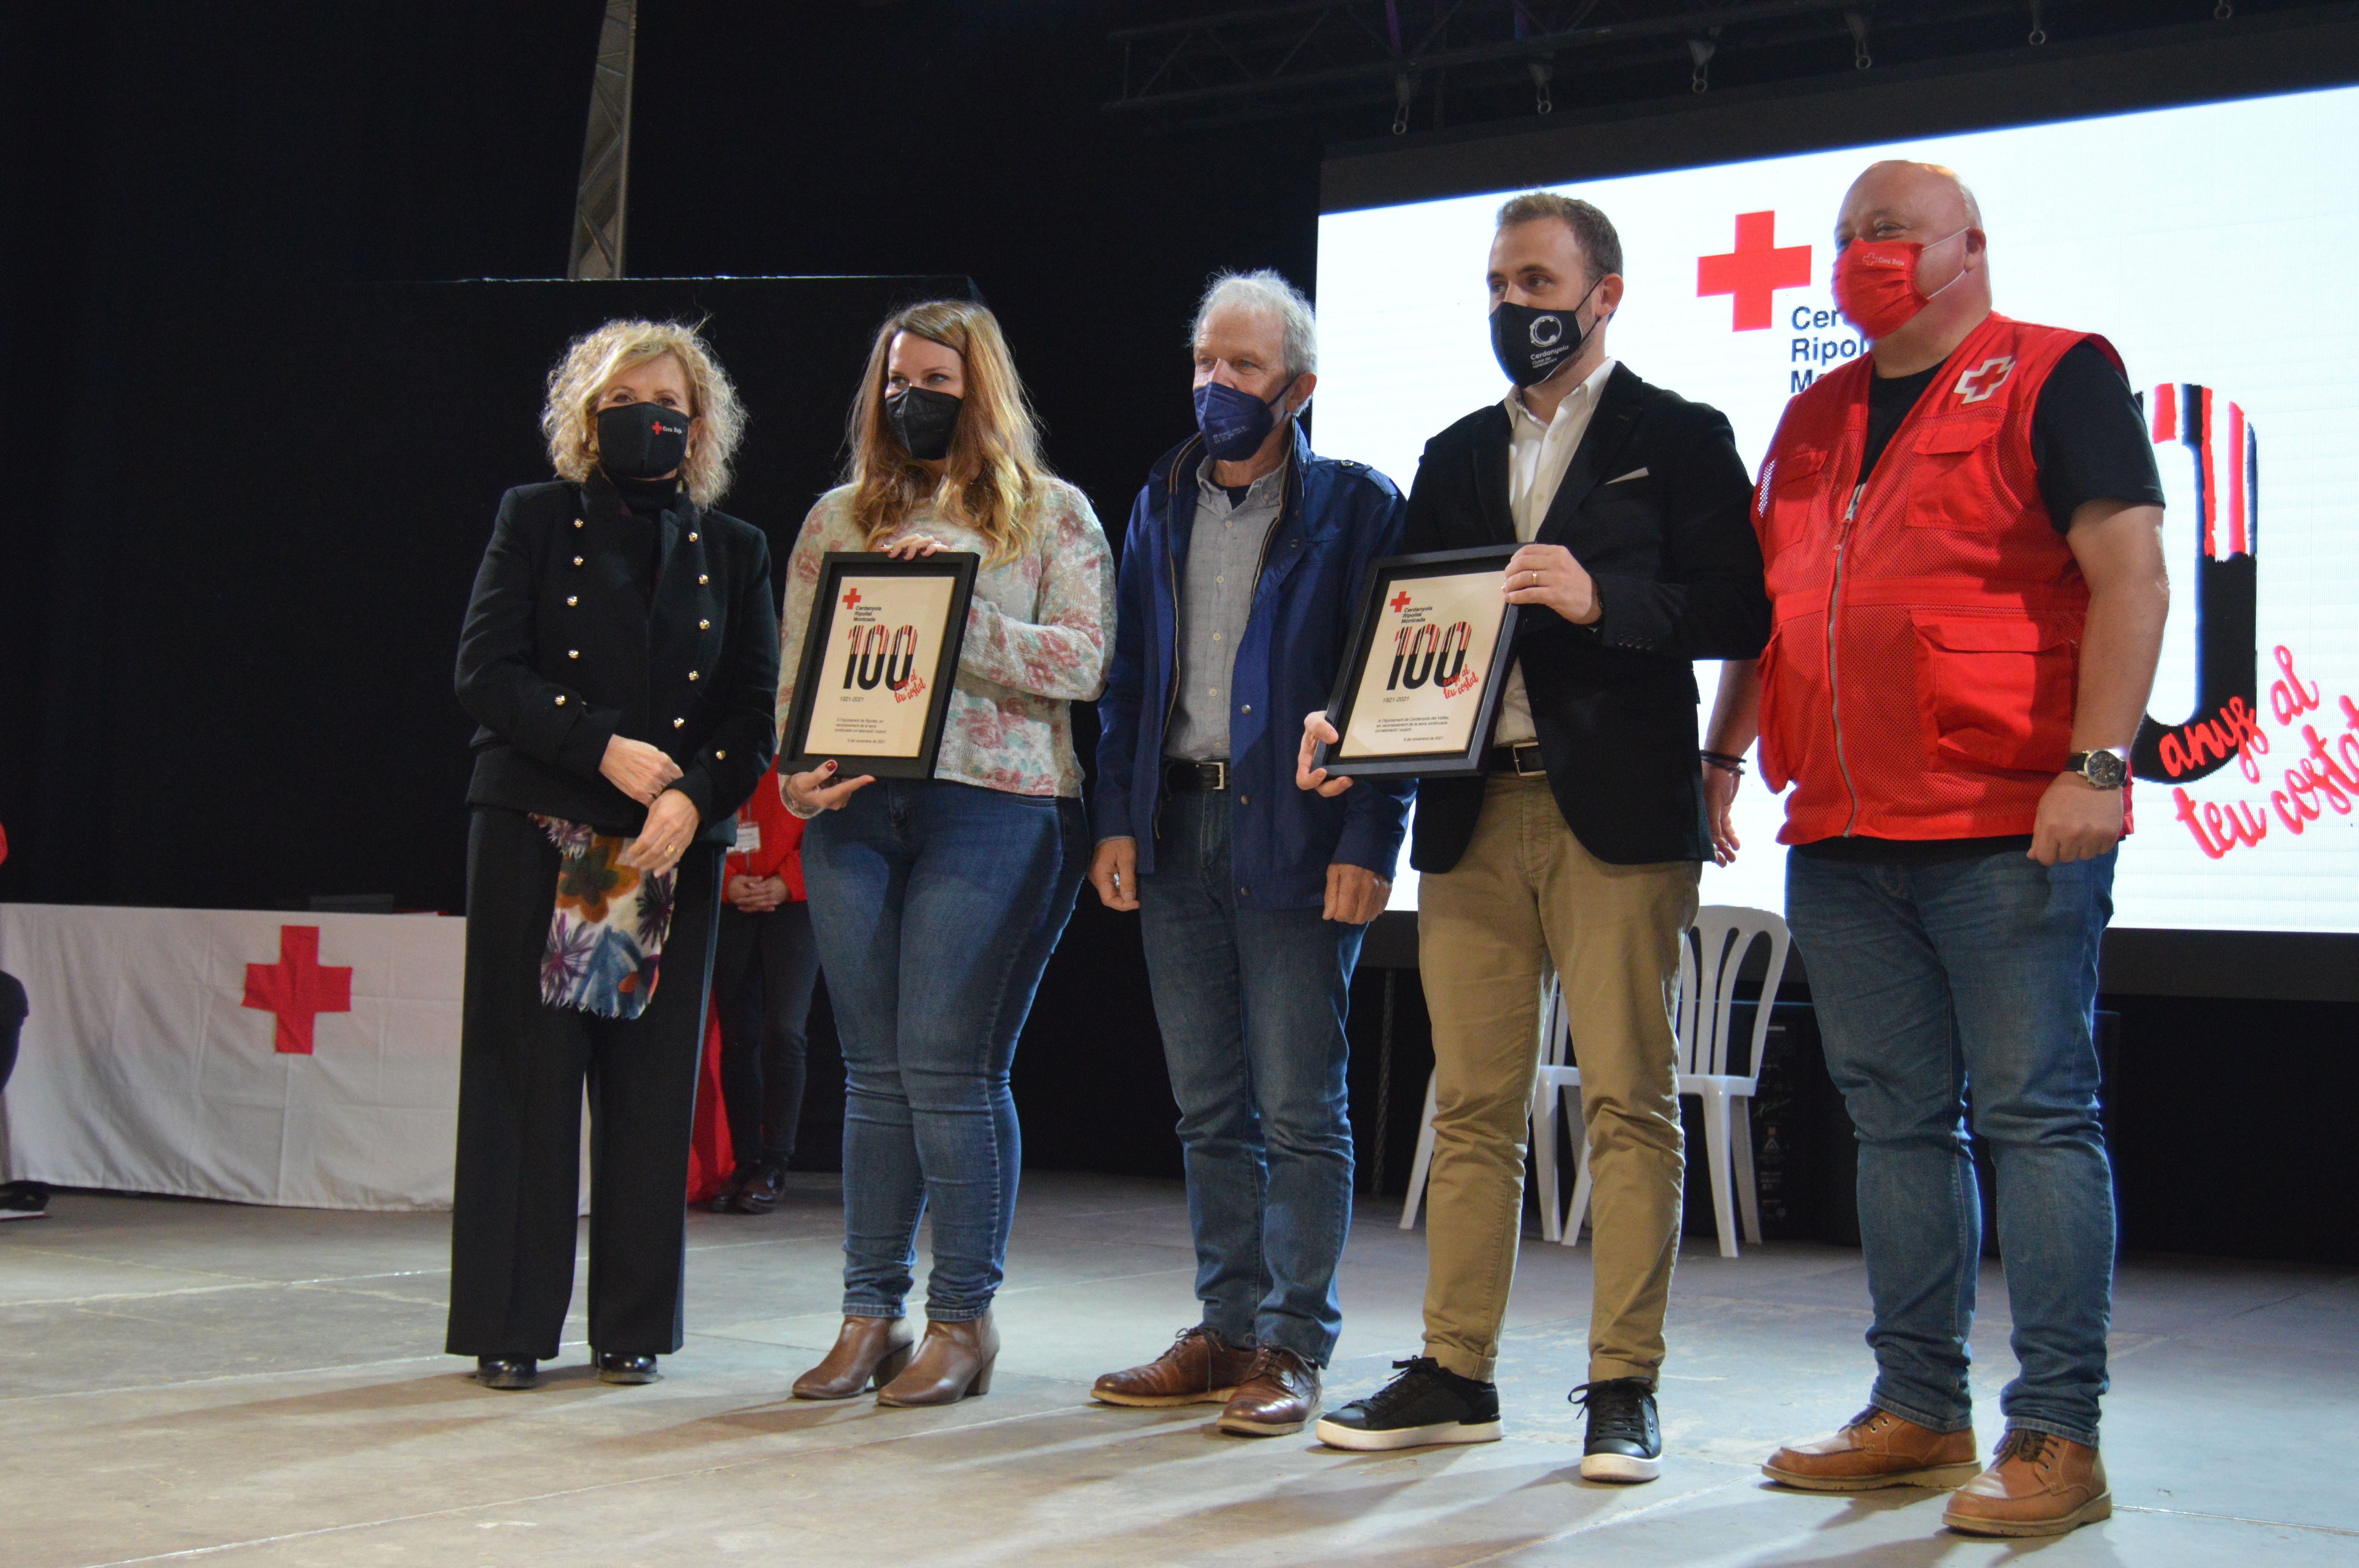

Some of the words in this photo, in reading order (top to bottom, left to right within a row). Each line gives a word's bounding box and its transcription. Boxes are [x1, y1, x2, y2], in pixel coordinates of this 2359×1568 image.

[1892, 258, 1904, 267] Roja
[1530, 345, 1569, 360] Cerdanyola
[843, 624, 918, 691] 100
[1387, 621, 1472, 690] 100
[911, 668, 917, 682] al
[1462, 664, 1470, 677] al
[894, 690, 906, 703] teu
[908, 677, 926, 699] costat
[1443, 688, 1457, 699] teu
[1458, 671, 1479, 694] costat
[2270, 645, 2319, 726] al
[2172, 786, 2267, 859] teu
